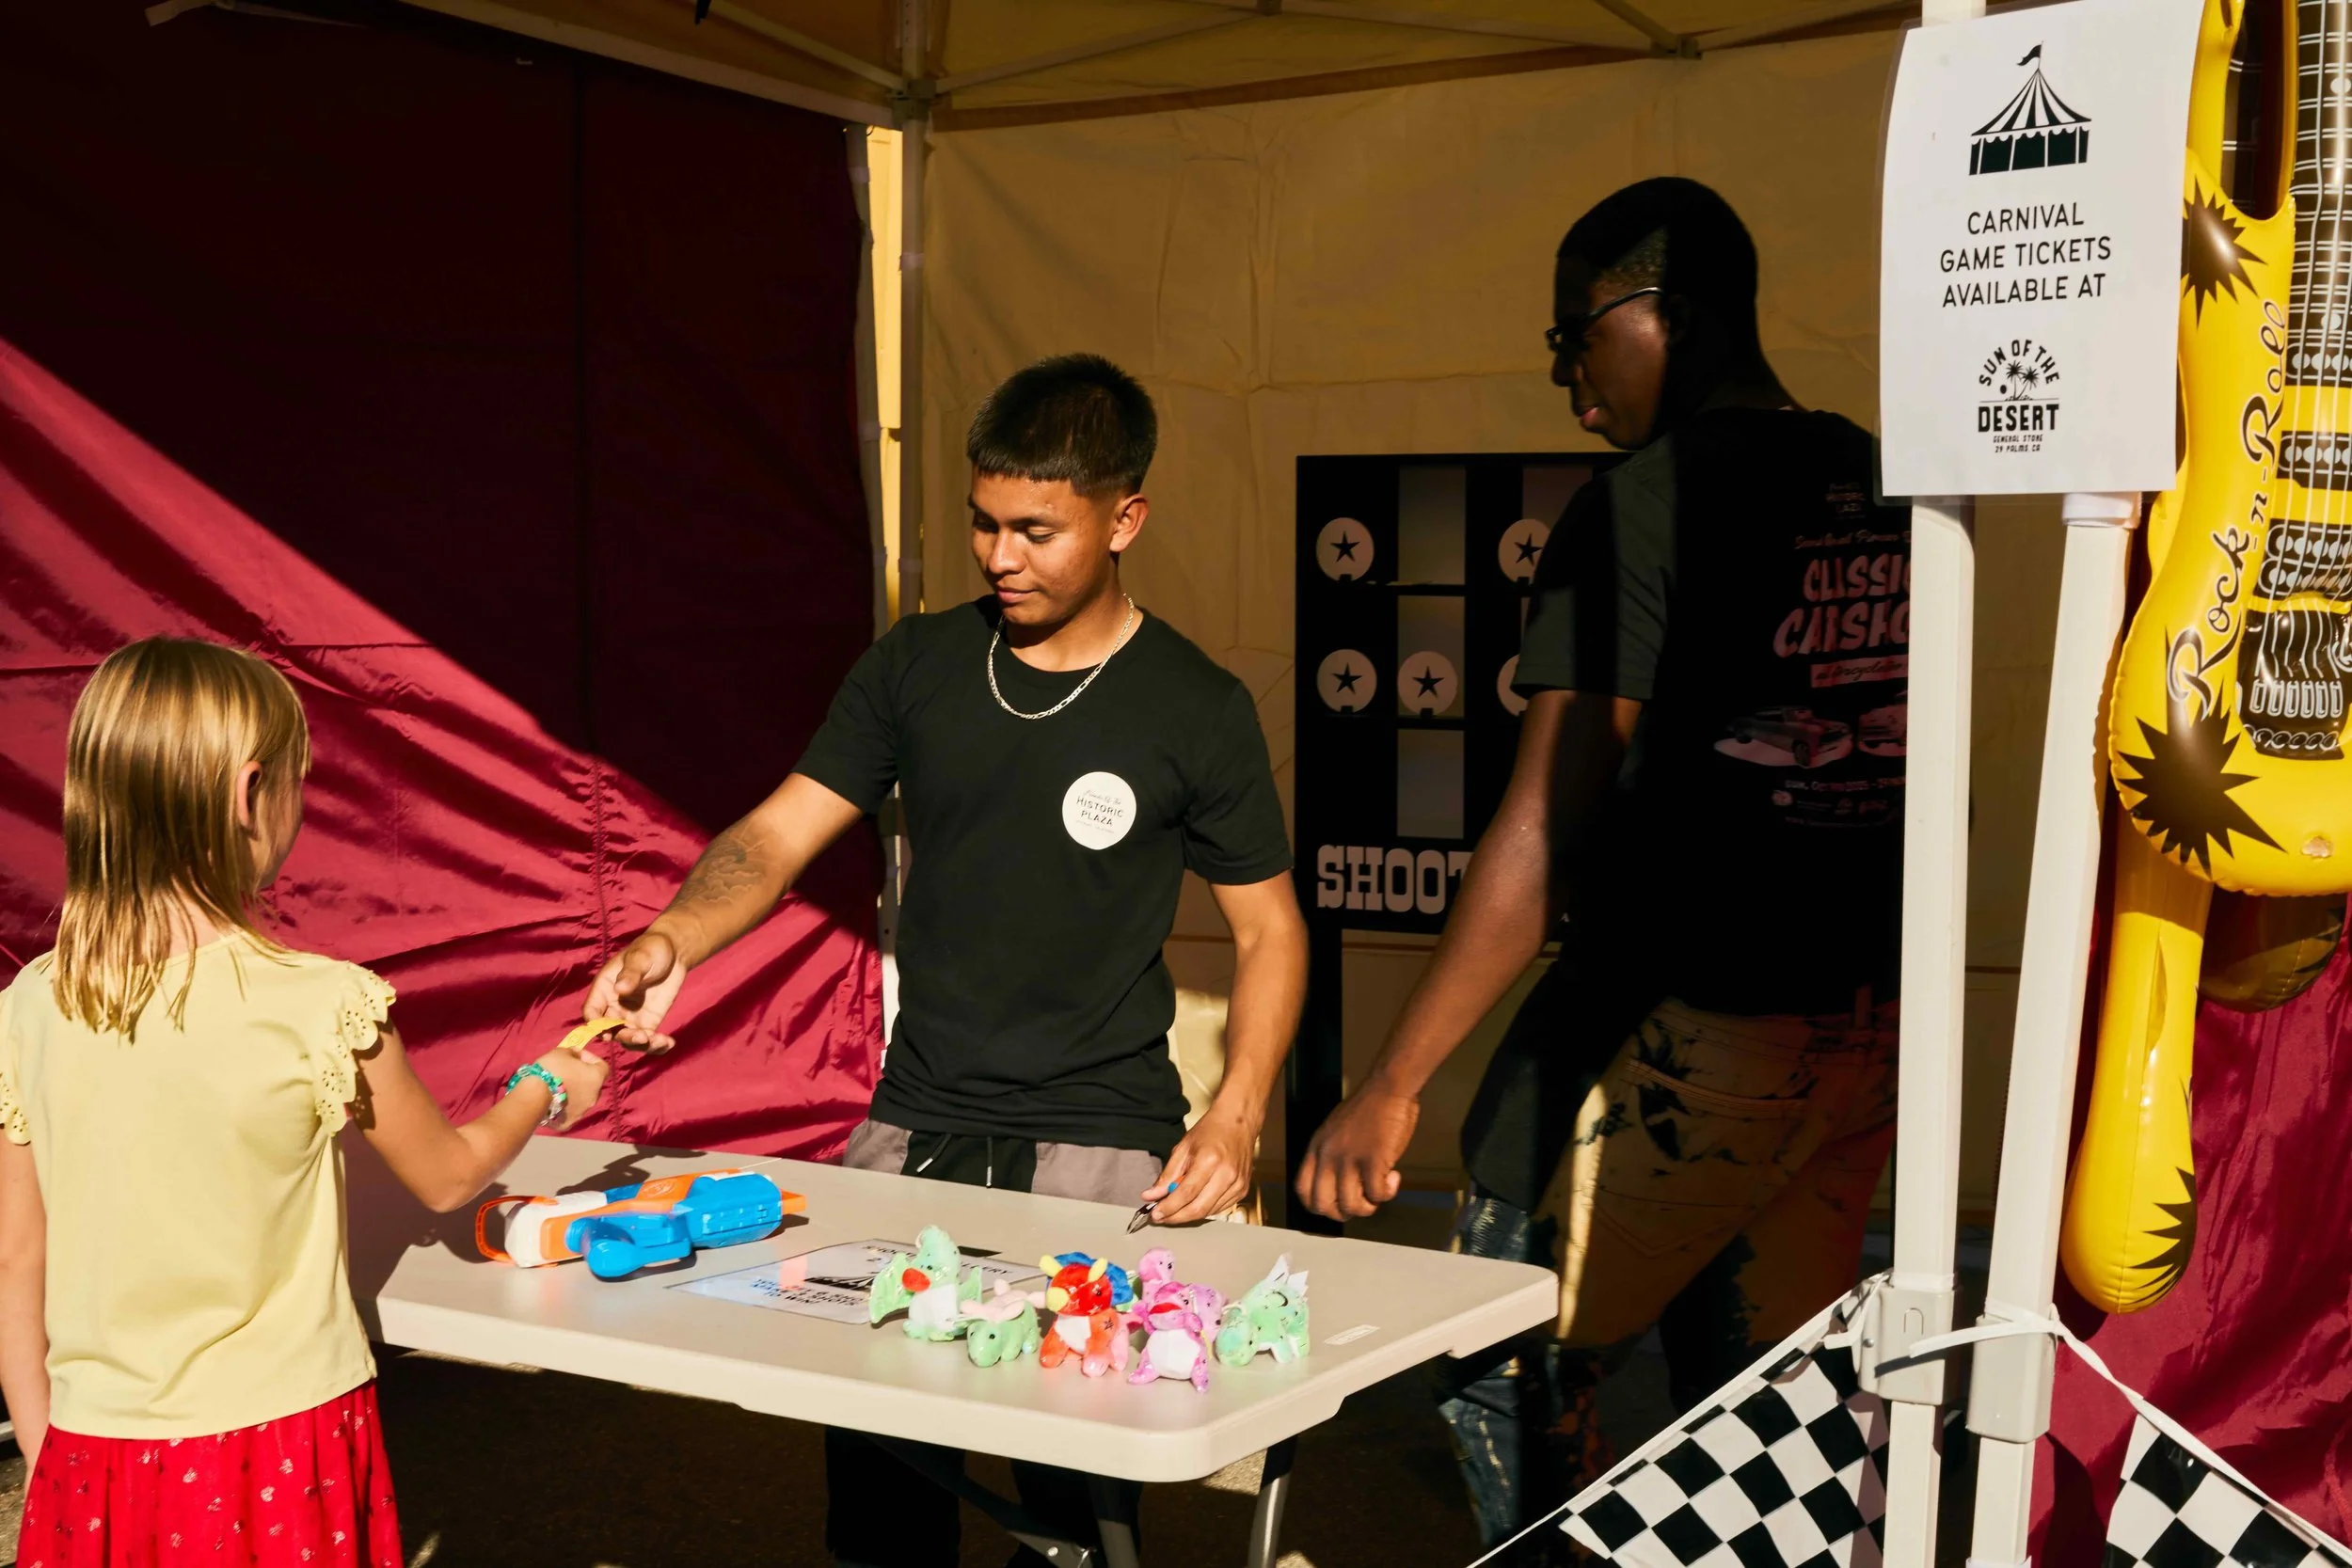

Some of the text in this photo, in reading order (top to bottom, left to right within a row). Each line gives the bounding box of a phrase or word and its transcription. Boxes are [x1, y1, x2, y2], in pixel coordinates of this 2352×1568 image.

[1967, 201, 2085, 235] CARNIVAL
[1940, 235, 2112, 273] GAME TICKETS
[1942, 272, 2106, 308] AVAILABLE AT
[1979, 339, 2060, 387] SUN OF THE
[1978, 403, 2060, 433] DESERT
[1993, 434, 2043, 444] GENERAL STORE
[1994, 443, 2041, 453] 29 PALMS CA
[2167, 525, 2250, 722] Rock
[2241, 299, 2287, 470] Roll
[1075, 796, 1124, 817] HISTORIC
[1080, 810, 1113, 827] PLAZA
